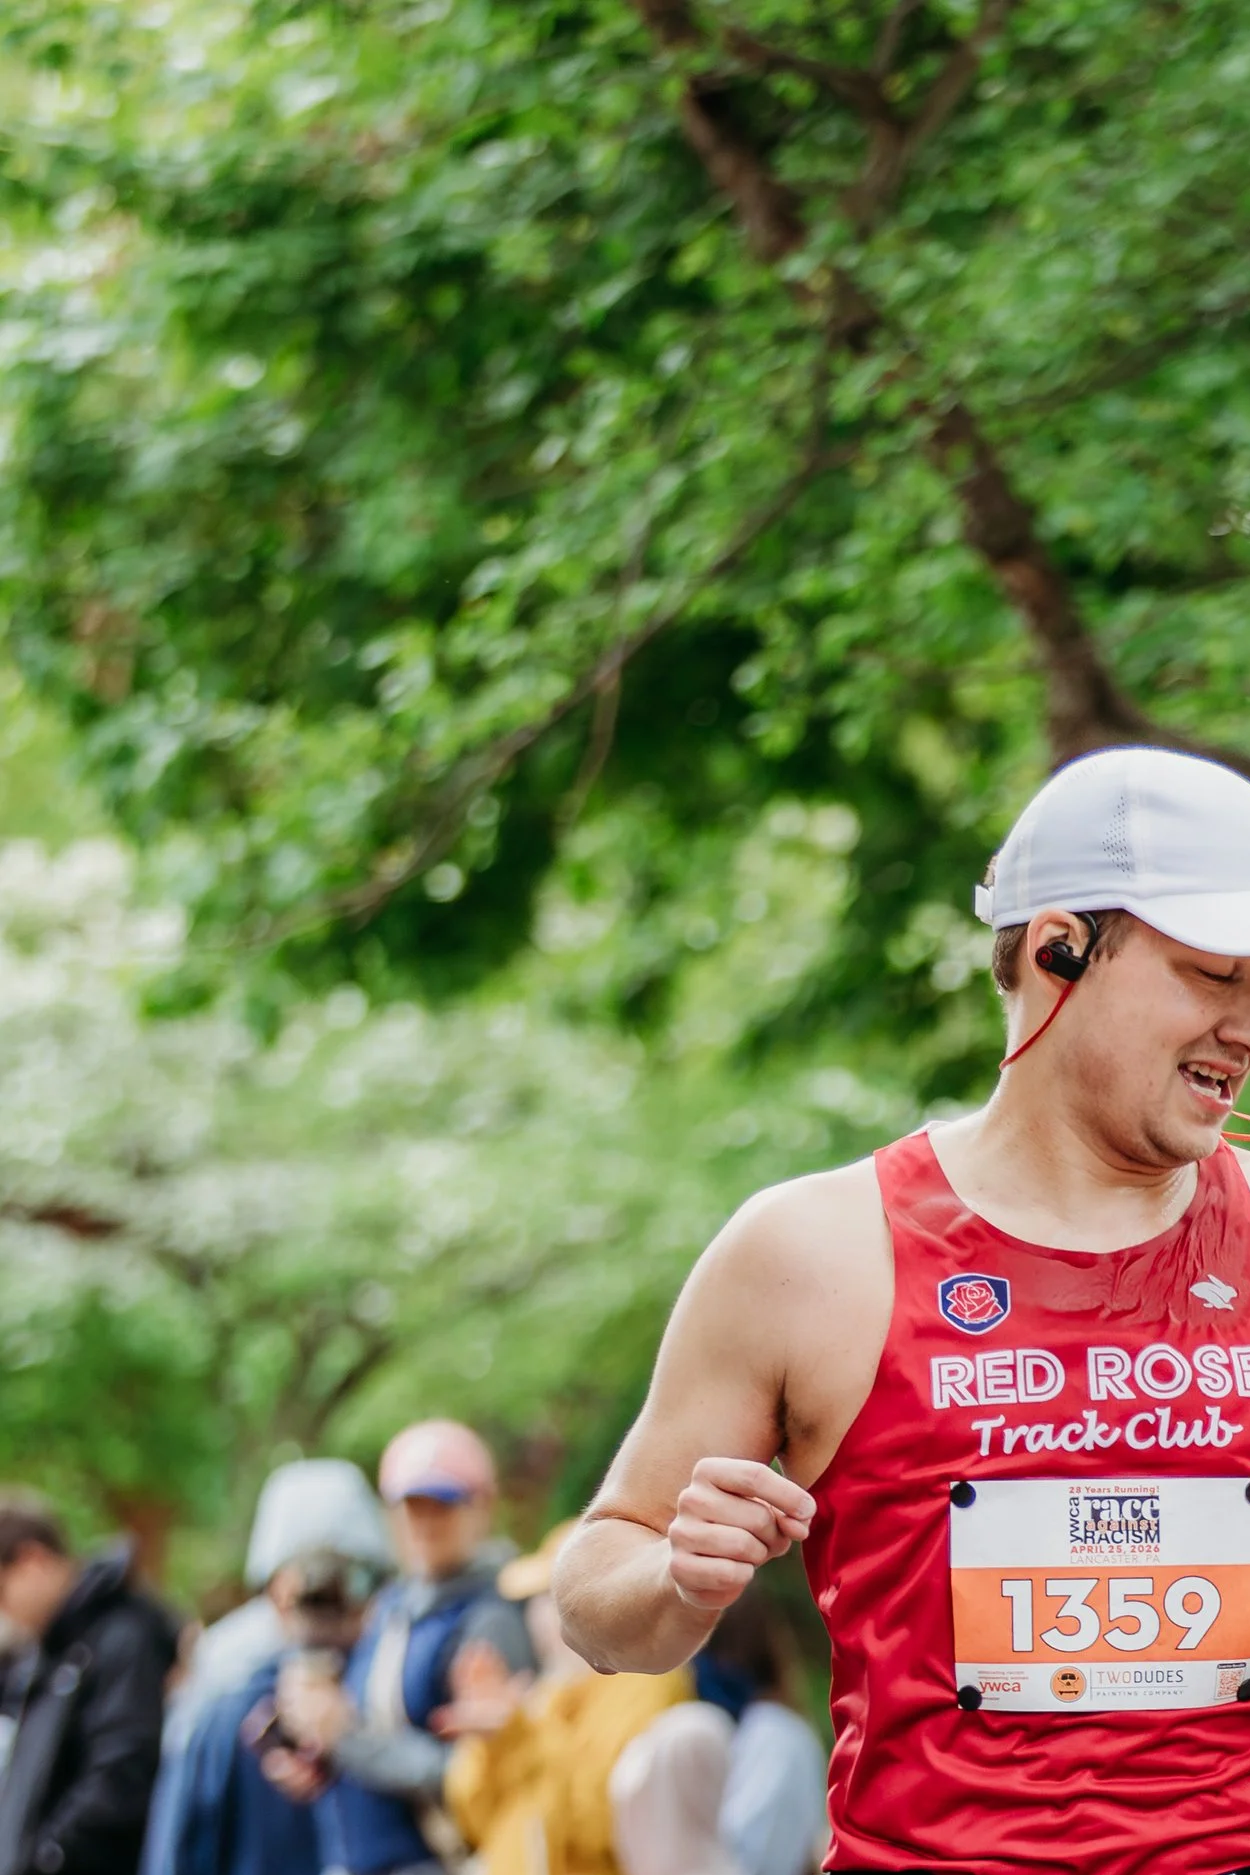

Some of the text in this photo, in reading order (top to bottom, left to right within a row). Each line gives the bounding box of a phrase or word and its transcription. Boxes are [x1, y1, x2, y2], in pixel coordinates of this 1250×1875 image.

[930, 1348, 1066, 1410] RED
[971, 1406, 1243, 1457] Track Club
[1069, 1485, 1160, 1495] 28 Years Running!
[1083, 1498, 1160, 1521] race
[1069, 1496, 1083, 1543] ywca
[1086, 1519, 1157, 1533] against
[1084, 1530, 1160, 1544] RACISM
[1071, 1544, 1160, 1555] APRIL 25, 2026
[1146, 1554, 1160, 1563] PA
[1000, 1575, 1222, 1653] 1359
[979, 1681, 1021, 1694] ywca
